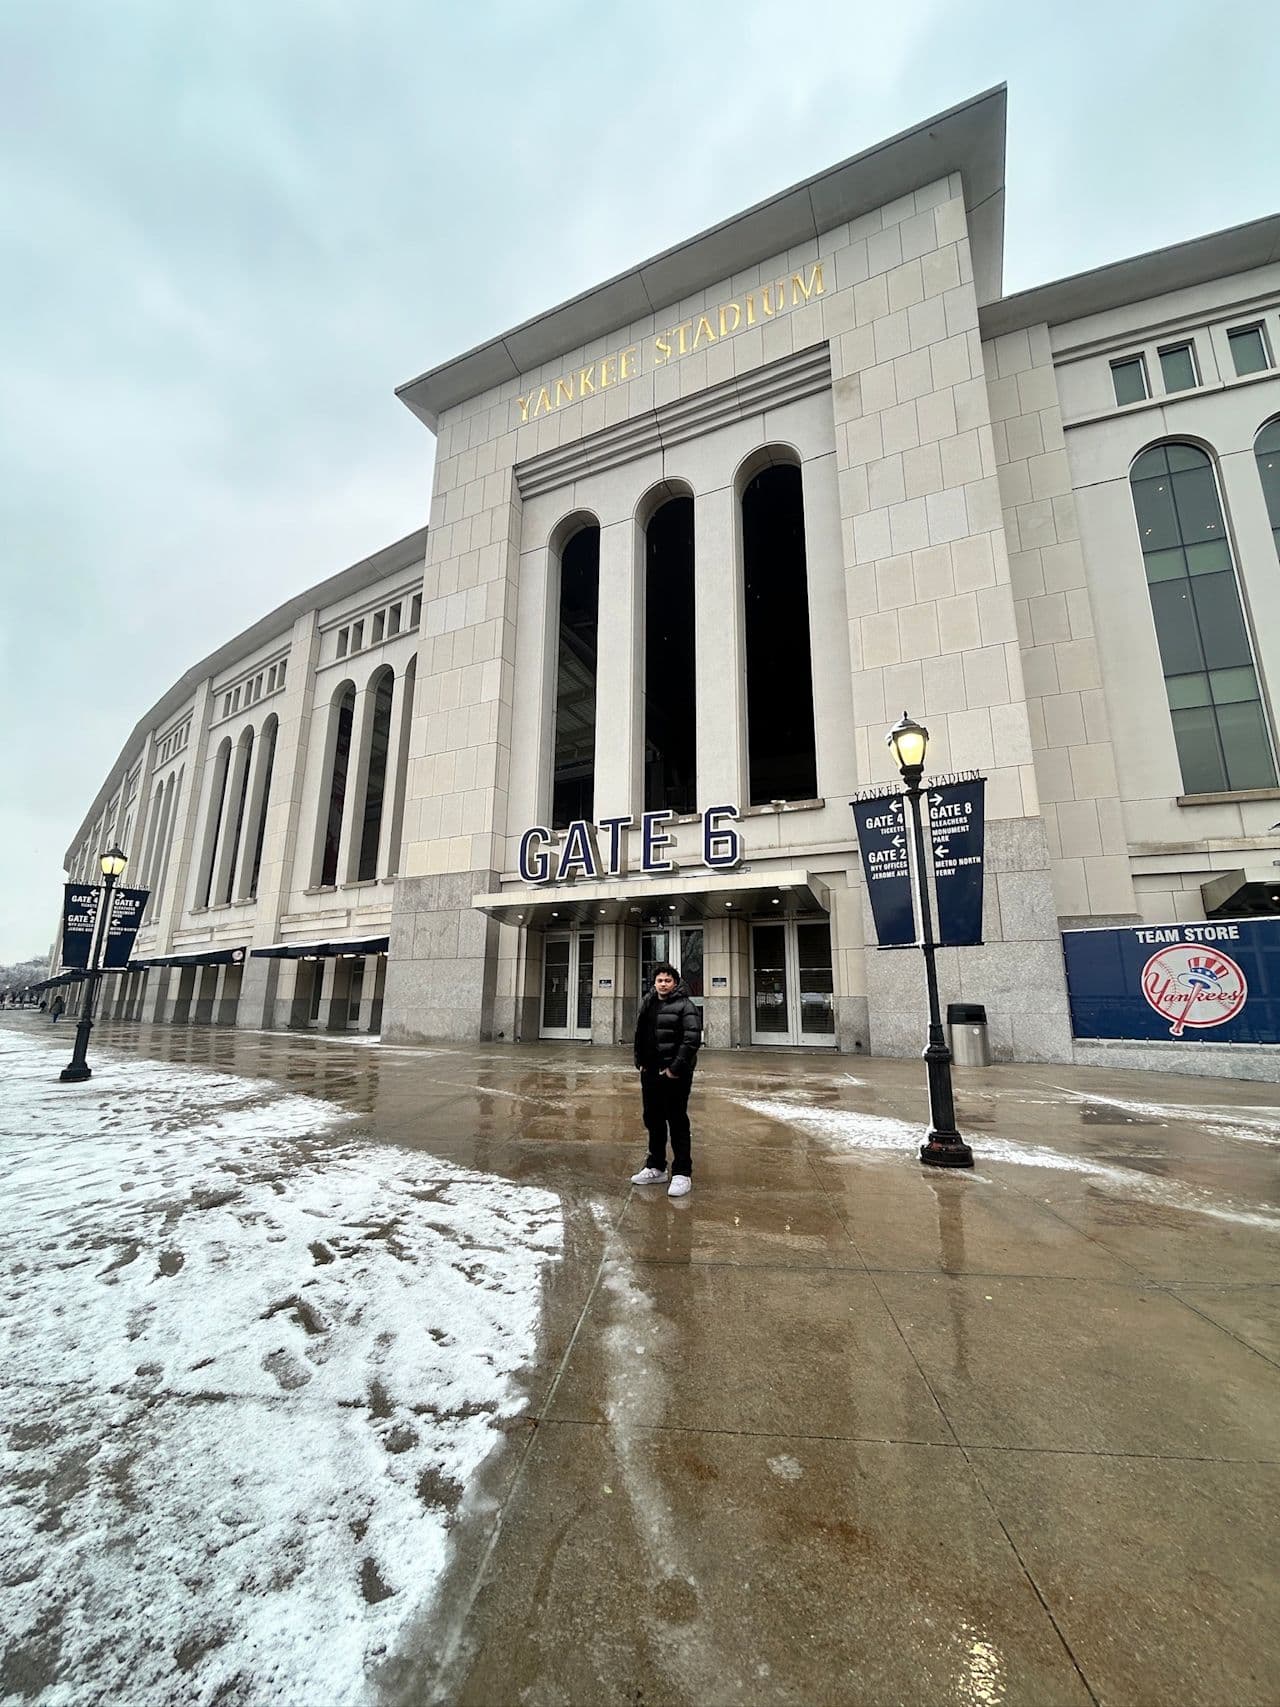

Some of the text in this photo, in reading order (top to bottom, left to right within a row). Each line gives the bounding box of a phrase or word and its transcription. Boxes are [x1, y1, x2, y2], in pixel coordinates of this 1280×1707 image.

[516, 262, 826, 423] YANKEE STADIUM
[854, 769, 981, 801] YANKEE STADIUM
[930, 802, 973, 819] GATE 8
[866, 813, 904, 829] GATE 4
[931, 816, 968, 828] BLEACHERS
[881, 826, 905, 835] TICKETS
[932, 825, 970, 836] MONUMENT
[518, 804, 743, 884] GATE 6
[933, 835, 950, 844] PARK
[868, 848, 907, 864] GATE 2
[935, 856, 981, 868] METRO NORTH
[883, 861, 908, 871] OFFICES
[872, 869, 909, 880] JEROME AVE
[936, 868, 955, 877] FERRY
[71, 895, 92, 904] GATE
[115, 899, 134, 907] GATE
[68, 914, 89, 923] GATE
[1135, 925, 1240, 944] TEAM STORE
[1145, 971, 1244, 1006] Yankees
